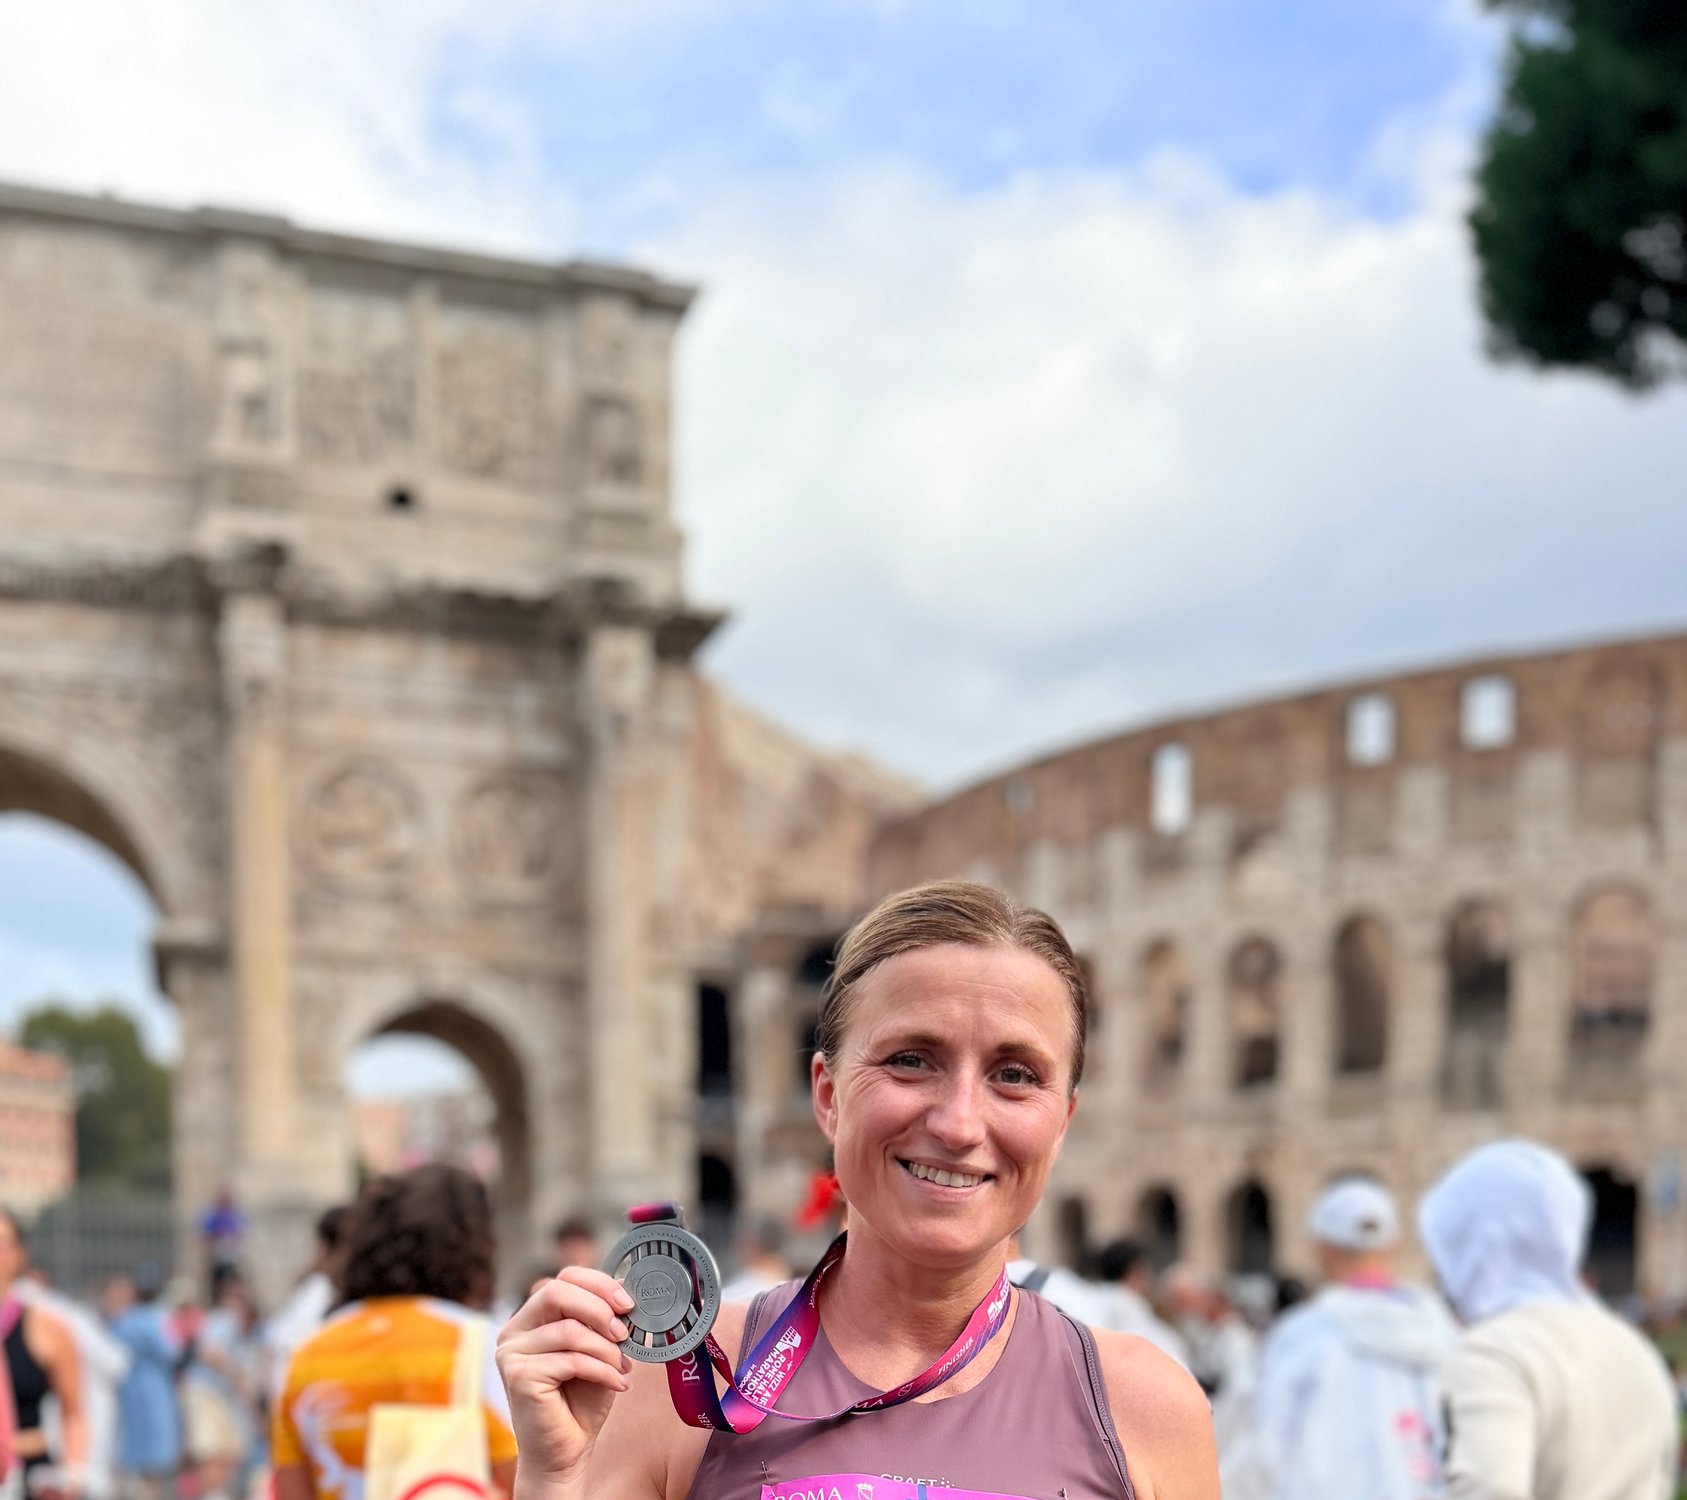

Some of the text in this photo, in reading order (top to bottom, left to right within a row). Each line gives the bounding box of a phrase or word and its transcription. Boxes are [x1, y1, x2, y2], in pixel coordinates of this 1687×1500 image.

[641, 1286, 672, 1298] ROMA
[742, 1347, 782, 1396] MARATHON
[938, 1336, 974, 1375] FINISHER
[751, 1354, 786, 1402] ROME HALF
[768, 1371, 786, 1392] WIZZ
